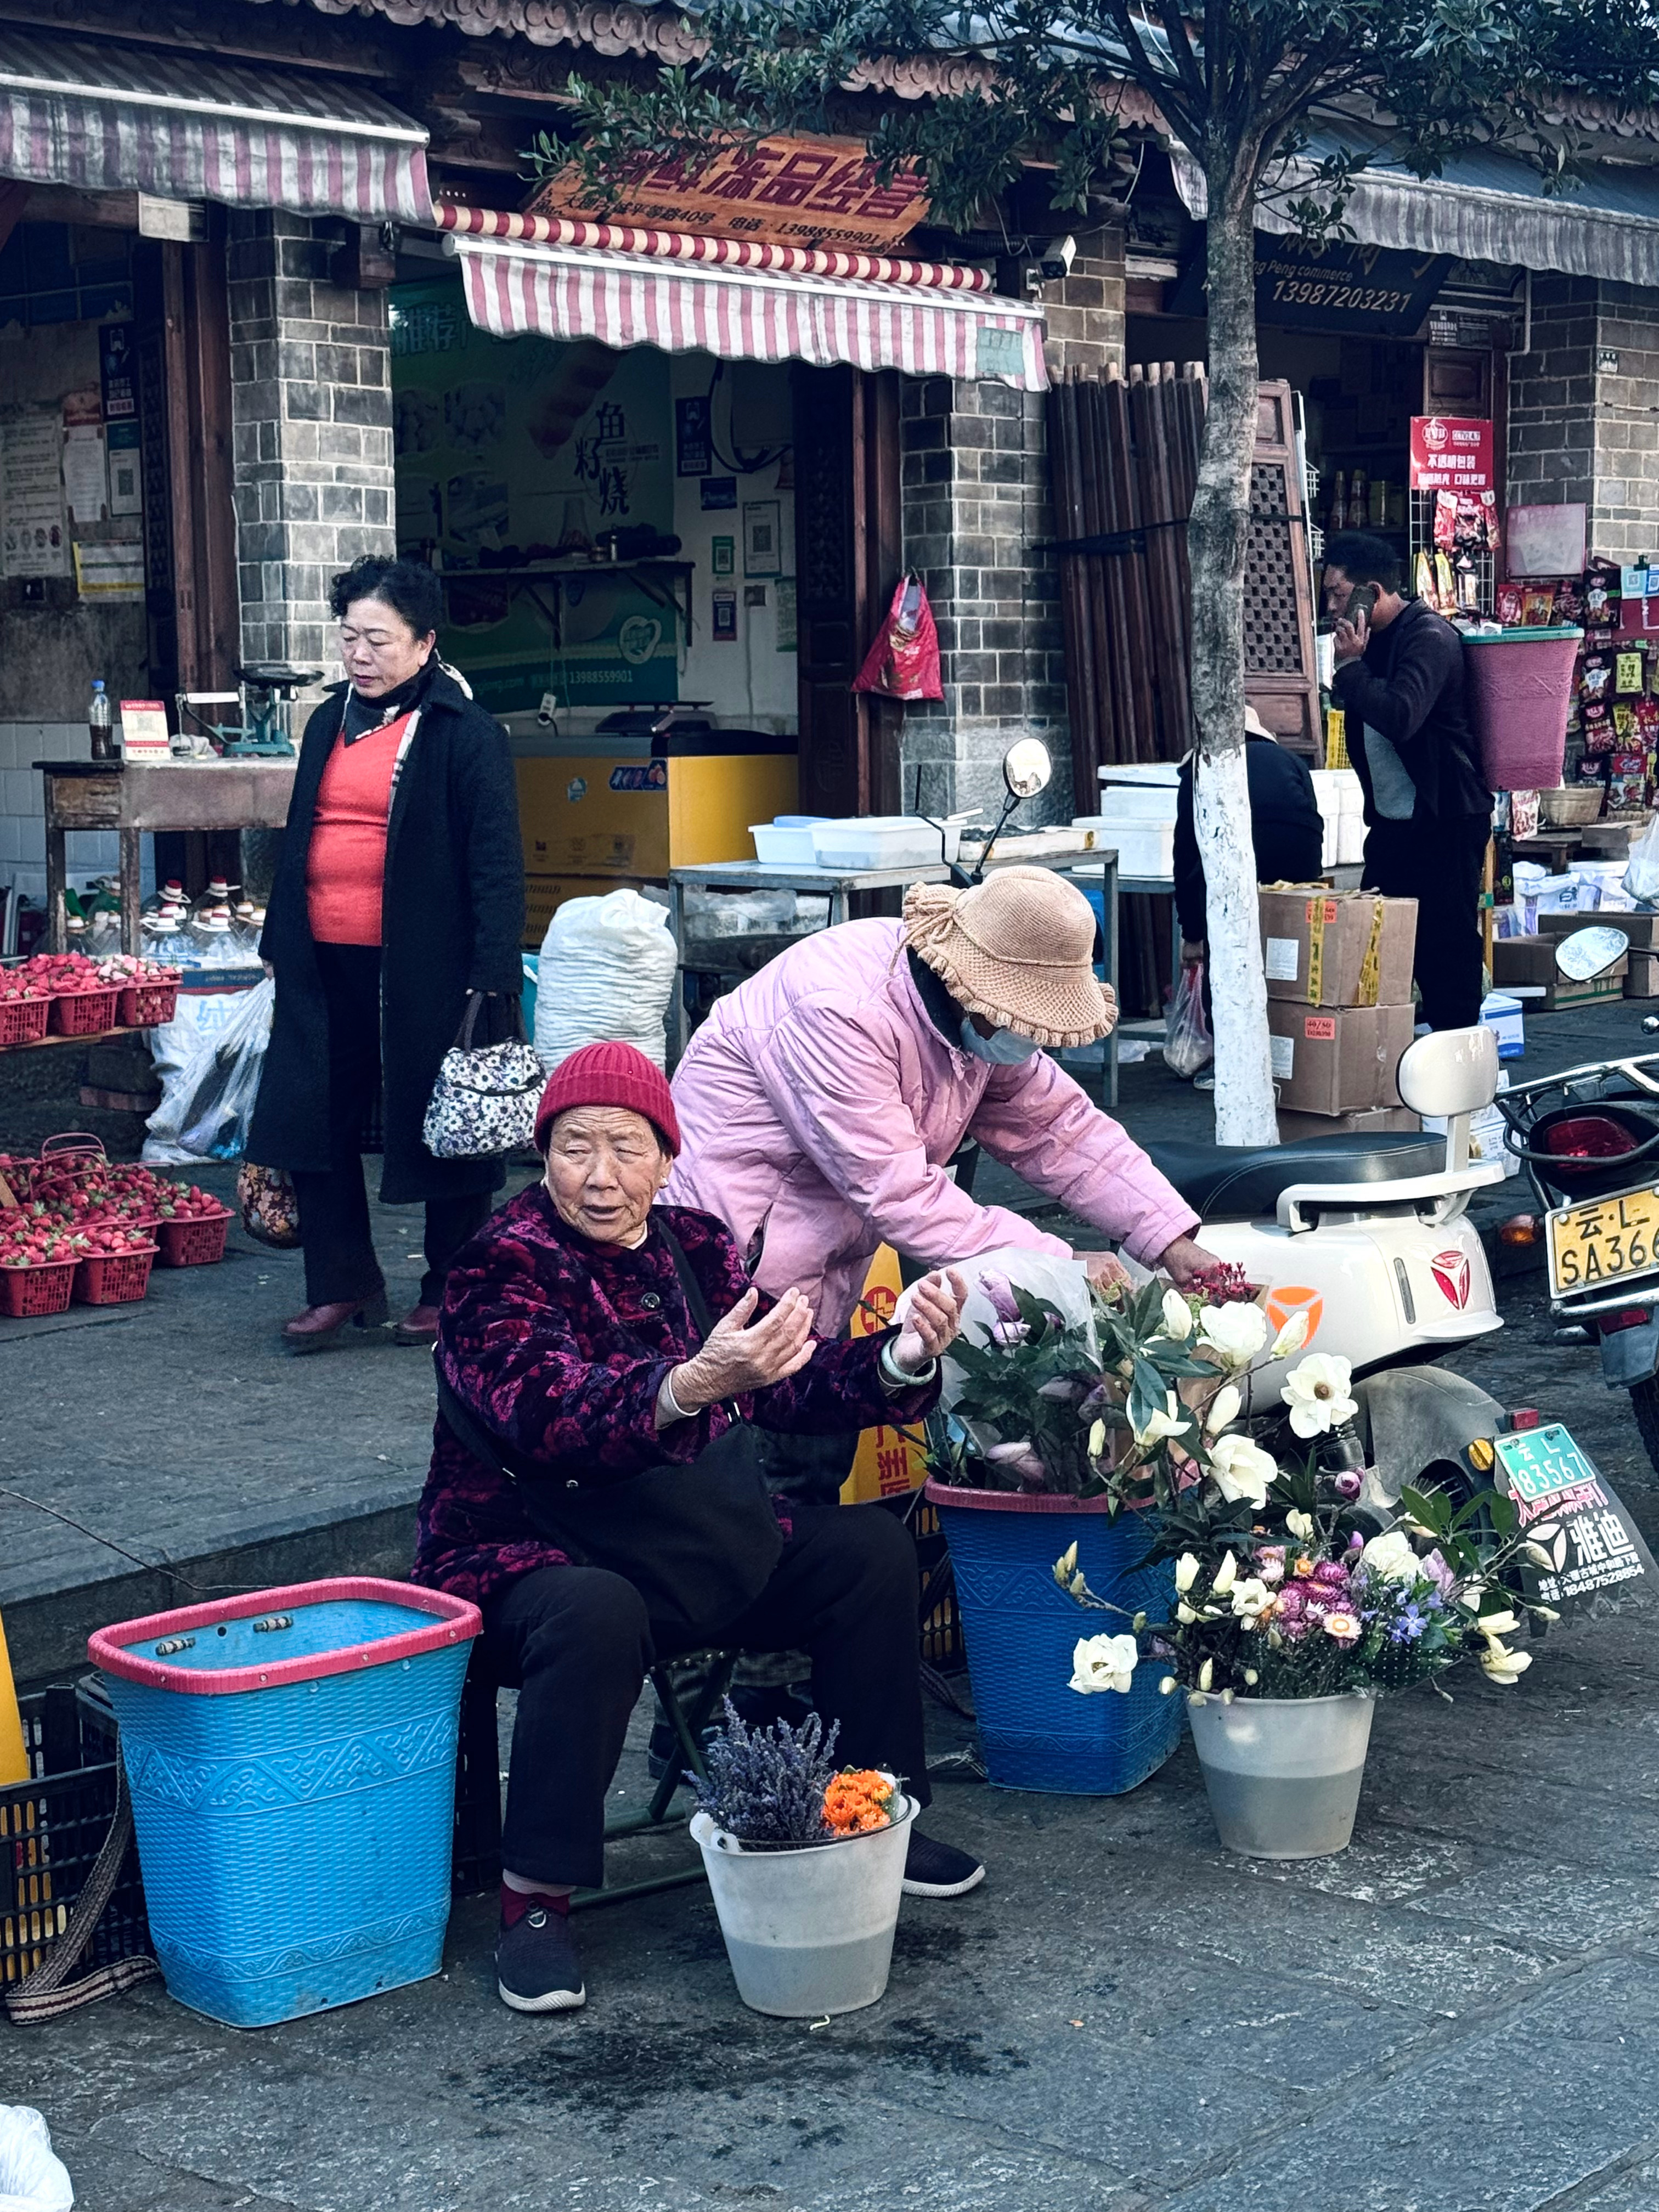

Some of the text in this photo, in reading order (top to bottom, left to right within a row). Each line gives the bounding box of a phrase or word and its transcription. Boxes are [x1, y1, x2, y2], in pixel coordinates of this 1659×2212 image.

[776, 222, 881, 245] 13988559901
[1267, 259, 1296, 279] Peng
[1297, 265, 1354, 283] commerce
[1272, 279, 1413, 313] 13987203231
[569, 669, 633, 684] 13988559901
[1517, 1453, 1587, 1495] 83567
[1566, 1509, 1635, 1567] 雅迪
